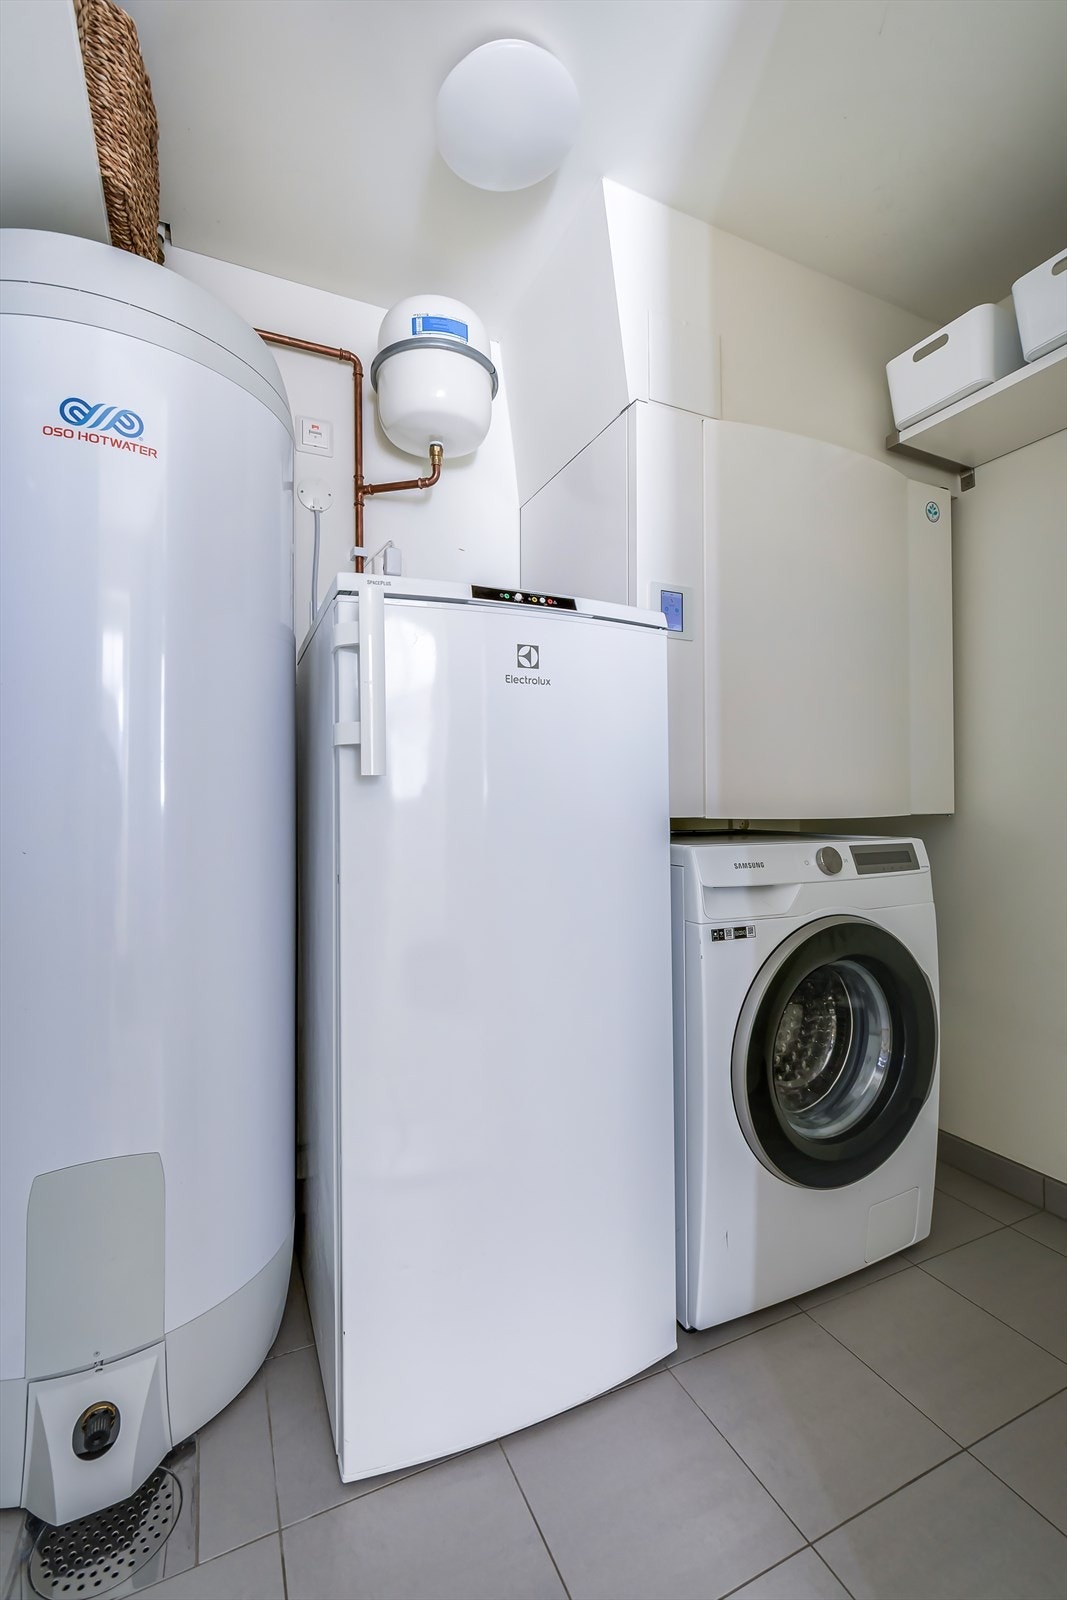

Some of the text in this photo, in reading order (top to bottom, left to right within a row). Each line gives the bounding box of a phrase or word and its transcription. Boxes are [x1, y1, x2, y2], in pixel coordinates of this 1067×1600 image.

[42, 425, 158, 458] OSO HOTWATER
[505, 674, 551, 686] Electrolux
[733, 861, 765, 870] SAMSUNG
